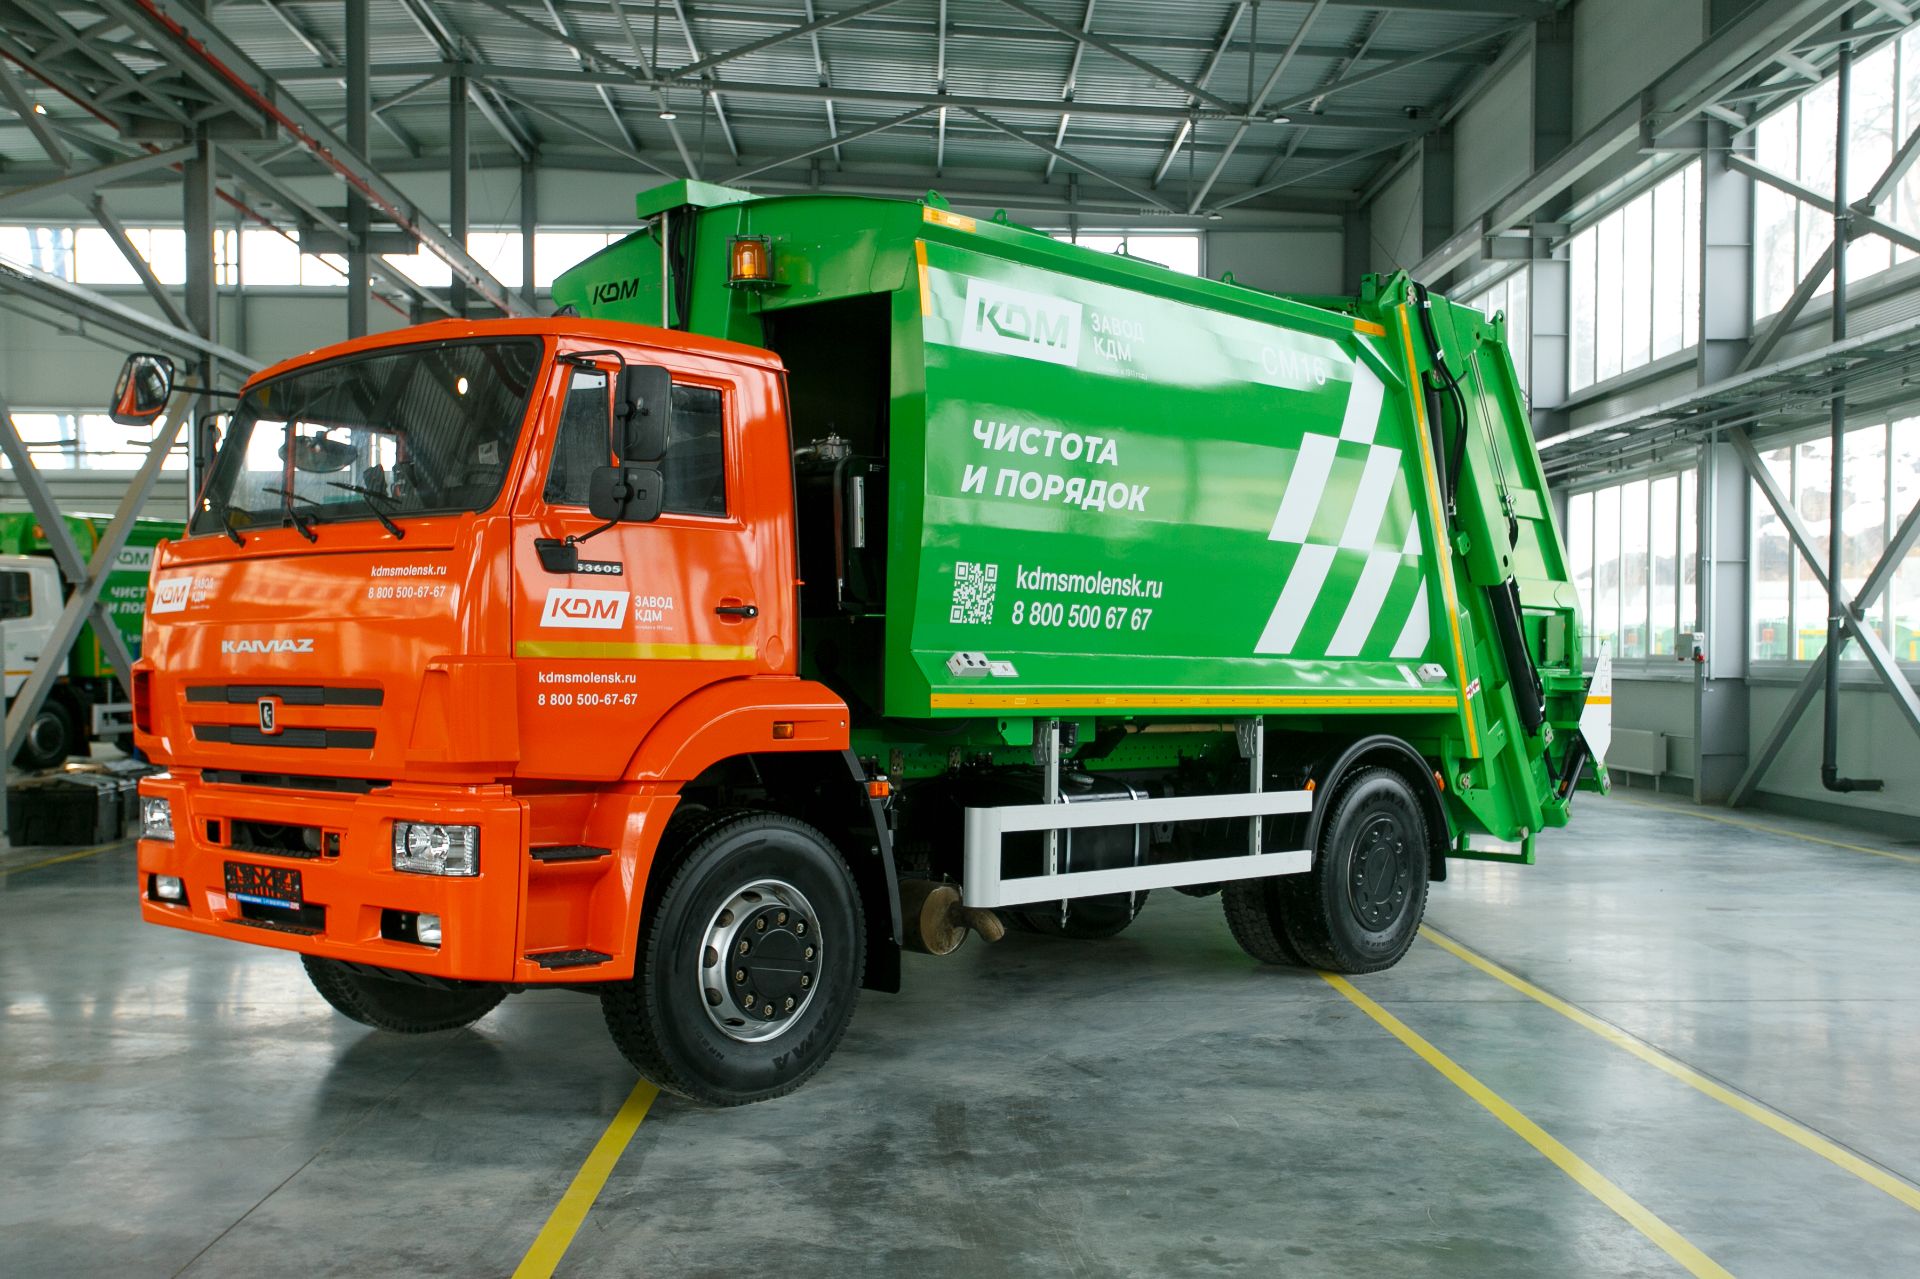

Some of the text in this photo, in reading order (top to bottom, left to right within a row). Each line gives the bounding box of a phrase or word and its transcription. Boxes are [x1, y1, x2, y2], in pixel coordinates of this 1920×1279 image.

[592, 278, 640, 305] KDM
[975, 297, 1070, 349] KDM
[1090, 312, 1145, 343] ЗАВОД
[1093, 336, 1132, 362] КДМ
[973, 419, 1118, 466] ЧИСТОТА
[960, 464, 1151, 512] И ПОРЯДОК
[370, 563, 447, 577] kdmsmolensk.ru
[1016, 564, 1163, 598] kdmsmolensk.ru
[368, 584, 446, 599] 8 800 500-67-67
[634, 595, 673, 610] ЗАВОД
[551, 597, 619, 619] KDM
[634, 609, 663, 623] КДМ
[1011, 600, 1153, 631] 8 800 500 67 67
[221, 639, 314, 653] KAMAZ
[538, 671, 637, 683] kdmsmolensk.ru
[538, 693, 638, 706] 8 800 500-67-67
